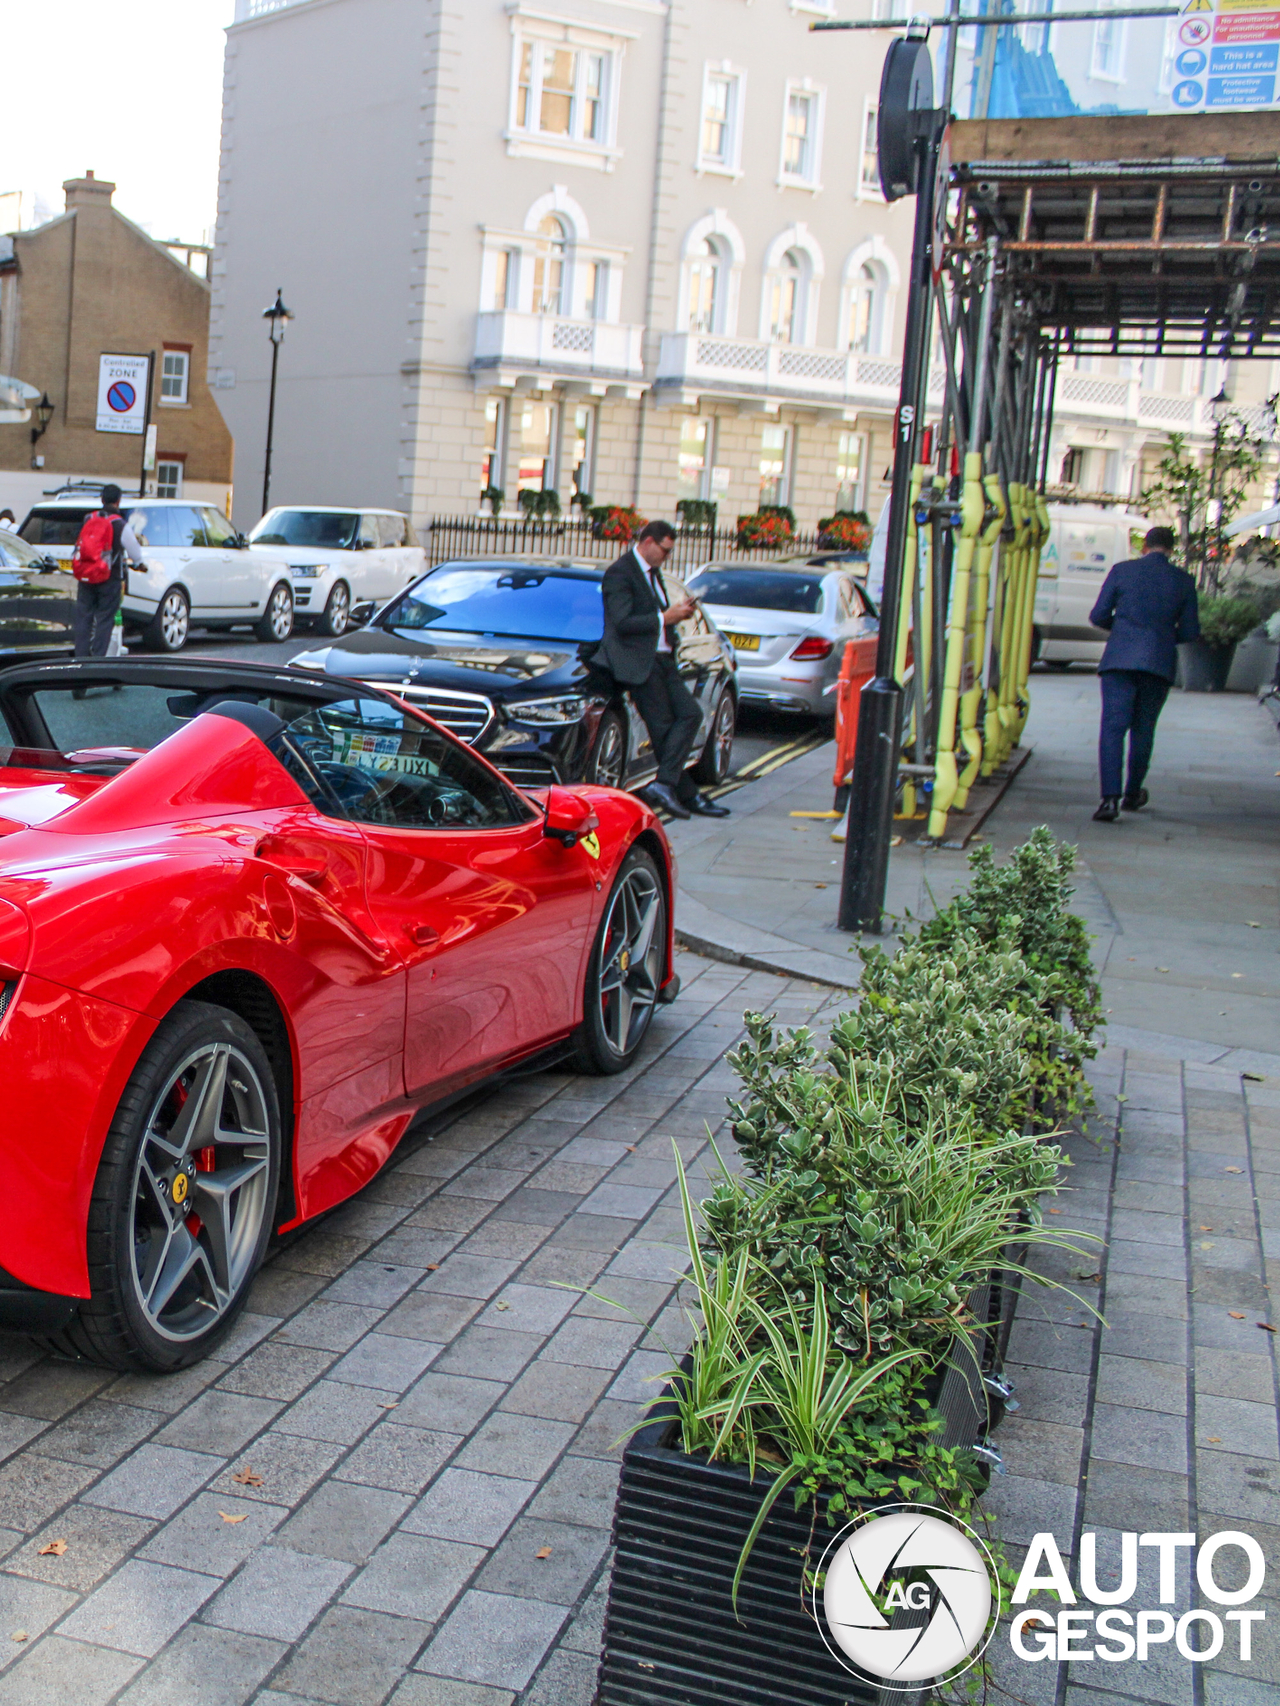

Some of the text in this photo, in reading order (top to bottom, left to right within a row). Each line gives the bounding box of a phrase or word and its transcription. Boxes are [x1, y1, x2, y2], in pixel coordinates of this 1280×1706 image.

[1233, 14, 1276, 23] admittance
[1229, 23, 1280, 32] unauthorised
[1227, 32, 1266, 41] personnel
[1223, 52, 1243, 60] This
[1245, 51, 1255, 59] is
[1212, 62, 1234, 71] hard
[1236, 62, 1252, 70] hat
[1221, 79, 1262, 87] Protective
[103, 358, 145, 367] Controlled
[109, 368, 138, 378] ZONE
